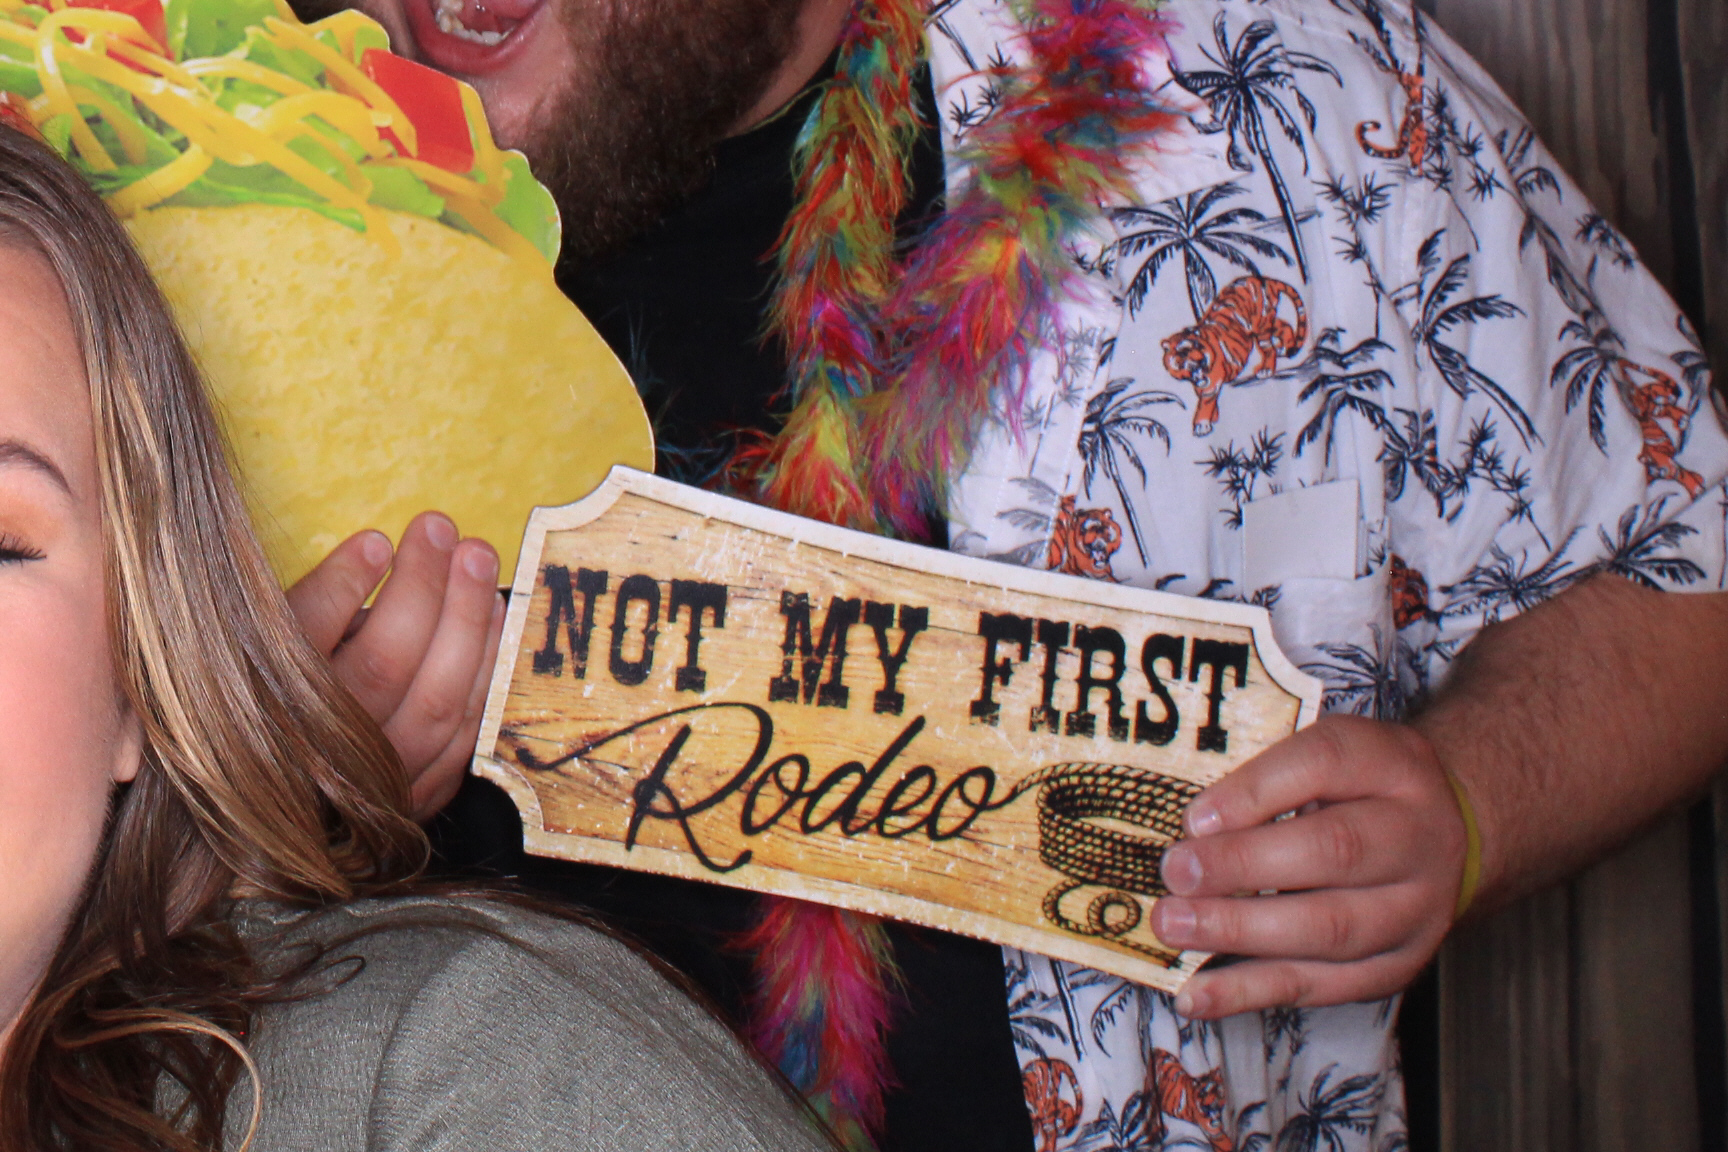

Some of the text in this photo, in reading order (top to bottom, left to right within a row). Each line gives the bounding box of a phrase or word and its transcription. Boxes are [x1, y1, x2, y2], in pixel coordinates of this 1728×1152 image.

[530, 564, 1252, 753] NOT MY FIRST
[515, 701, 1016, 873] Rodeo
